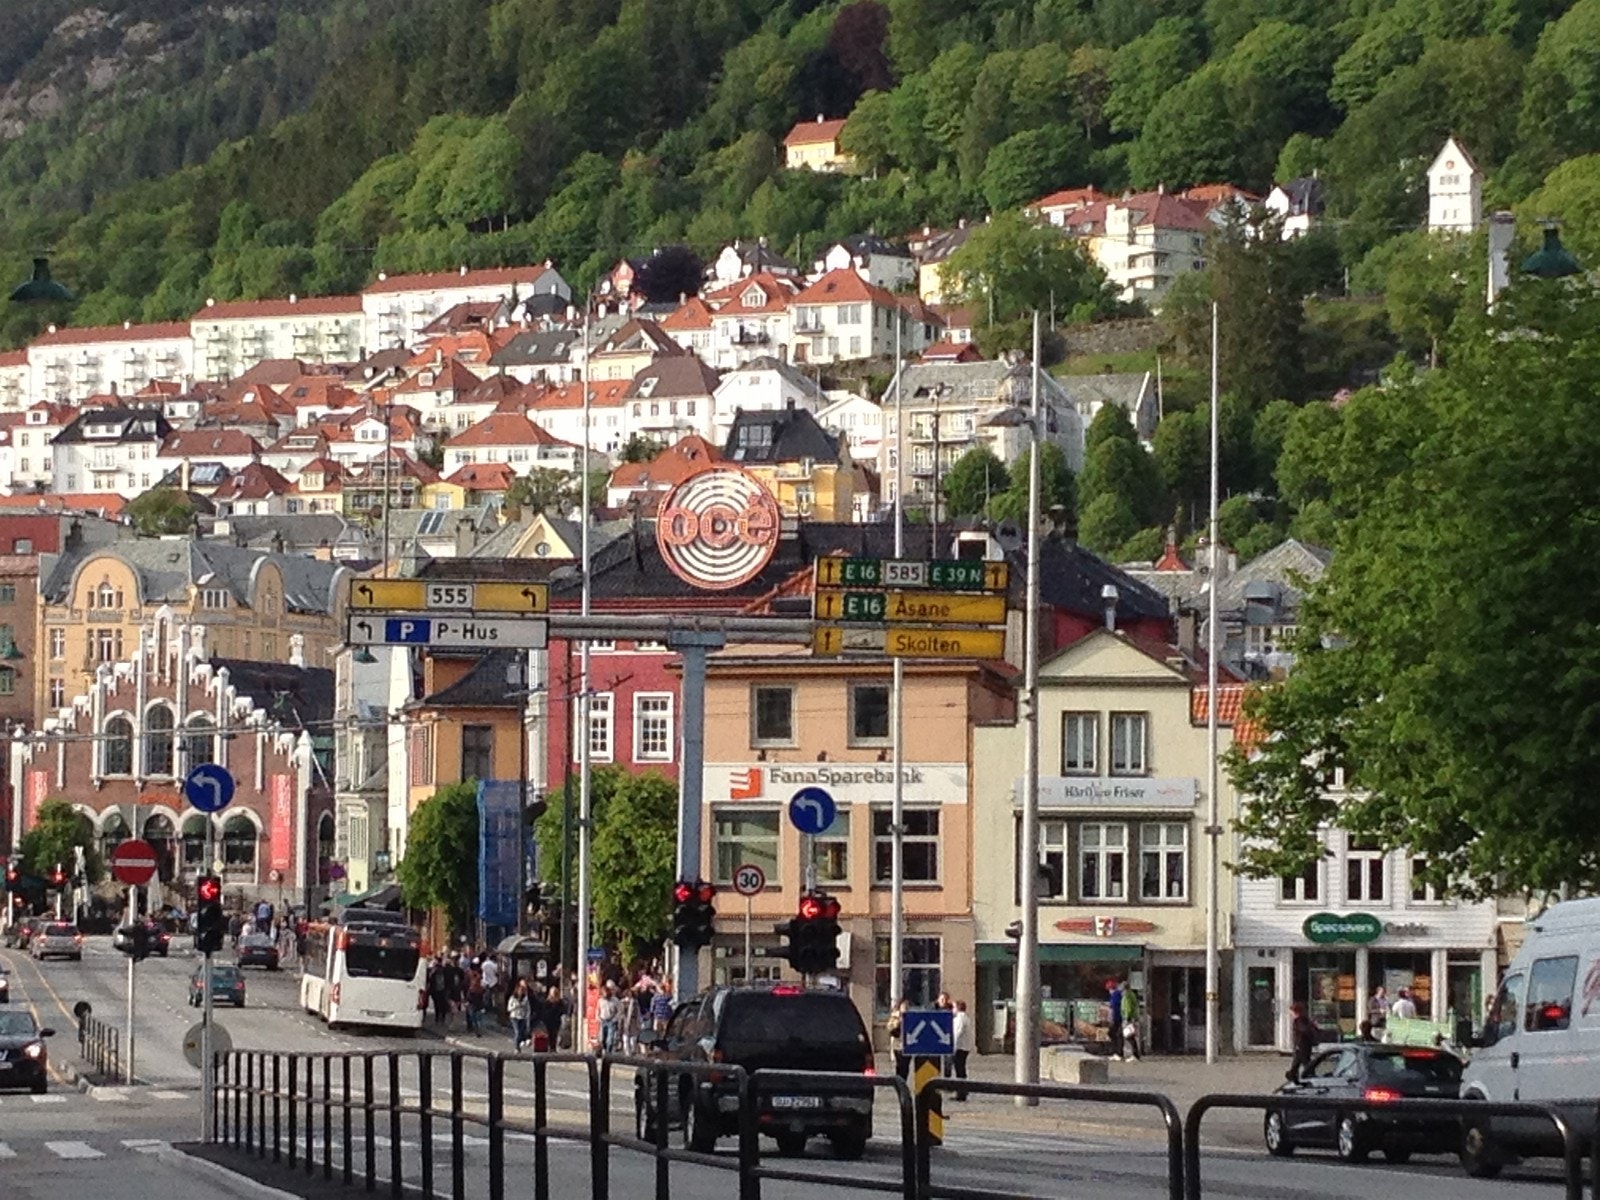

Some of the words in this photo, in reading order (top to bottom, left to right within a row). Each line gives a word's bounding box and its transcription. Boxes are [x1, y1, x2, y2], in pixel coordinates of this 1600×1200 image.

[846, 564, 856, 579] E
[860, 565, 876, 580] 16
[888, 565, 921, 581] 585
[932, 567, 941, 582] E
[947, 568, 966, 582] 39
[970, 568, 981, 583] N
[431, 587, 468, 605] 555
[849, 597, 859, 613] E
[863, 598, 881, 614] 16
[400, 622, 414, 641] P
[437, 622, 498, 641] P-Hus
[895, 634, 961, 652] Skolten
[769, 767, 924, 786] FanaSparebank
[740, 872, 760, 889] 30
